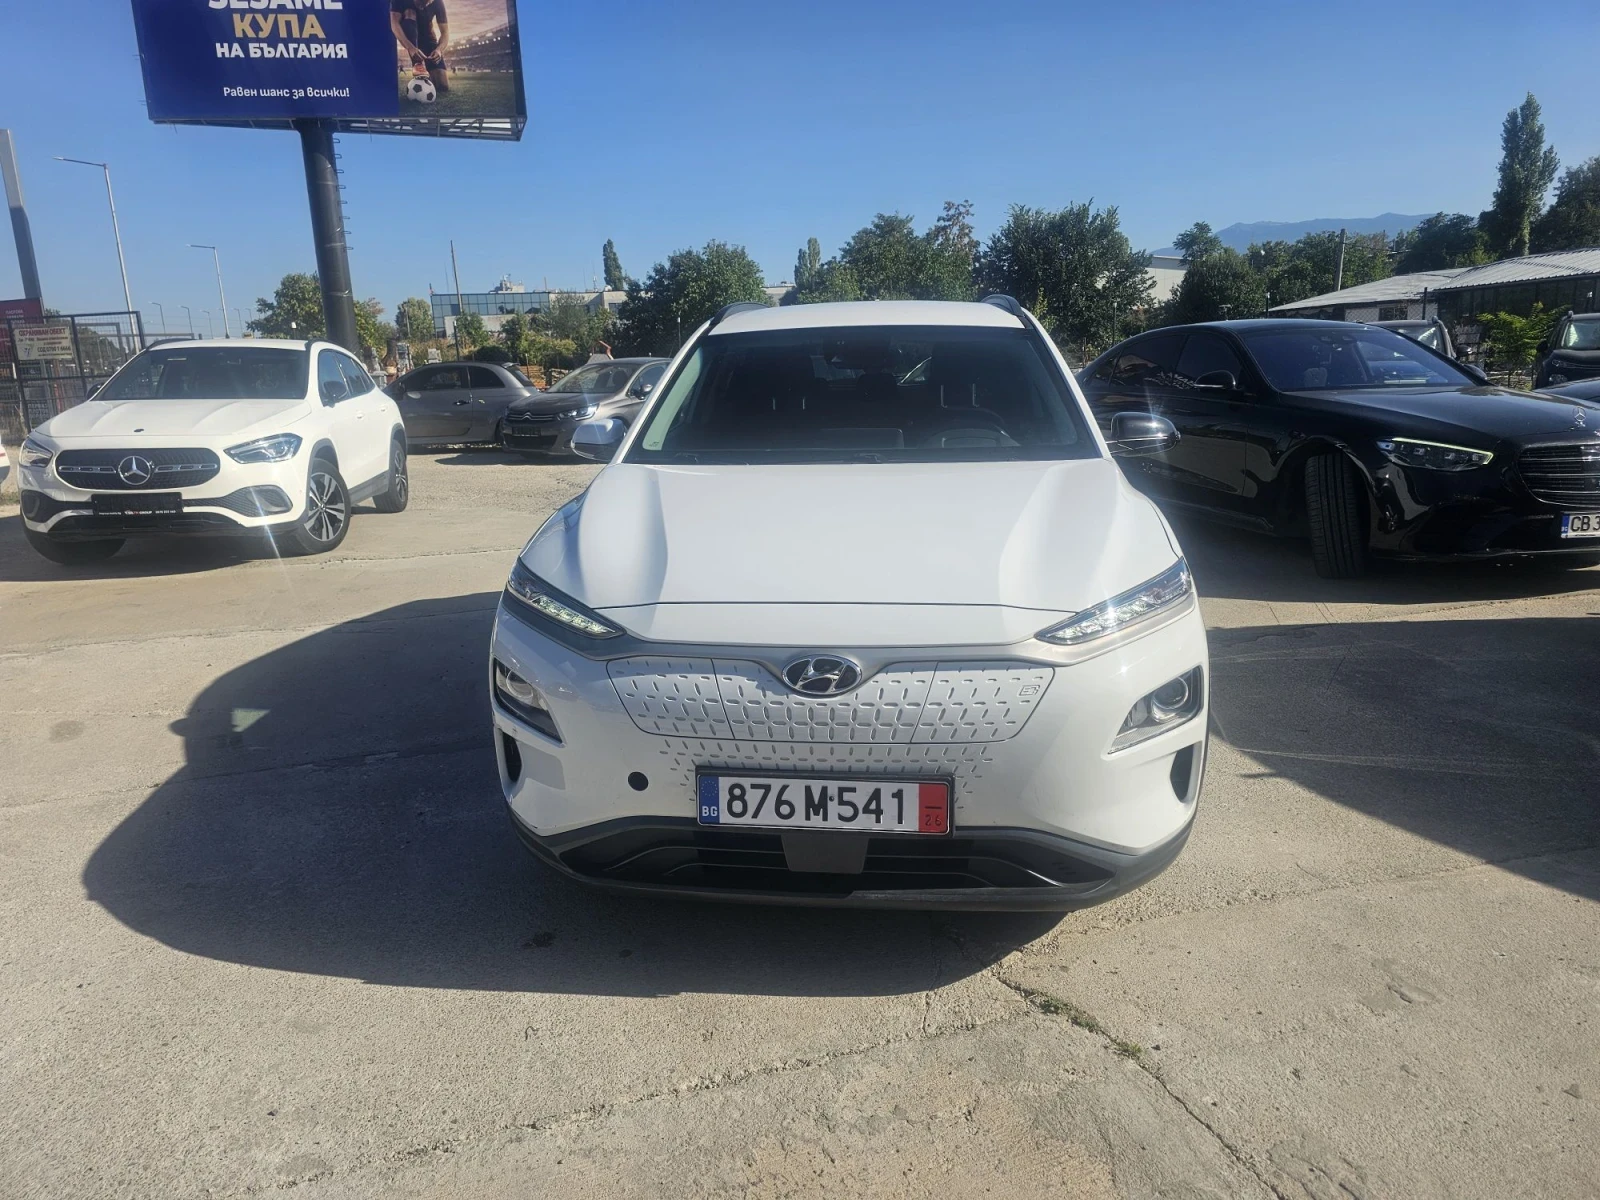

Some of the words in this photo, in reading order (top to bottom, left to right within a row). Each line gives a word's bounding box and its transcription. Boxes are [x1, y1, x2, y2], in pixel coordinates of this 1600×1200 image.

[233, 13, 327, 39] КУПА
[215, 42, 245, 58] НА
[248, 43, 348, 59] БЪЛГАРИЯ
[223, 86, 258, 97] Равен
[259, 88, 290, 97] шанс
[292, 88, 305, 99] за
[306, 86, 351, 98] всички!
[702, 805, 718, 817] BG
[726, 783, 796, 821] 876
[804, 785, 829, 822] M
[837, 786, 905, 824] 541
[925, 814, 942, 827] 26
